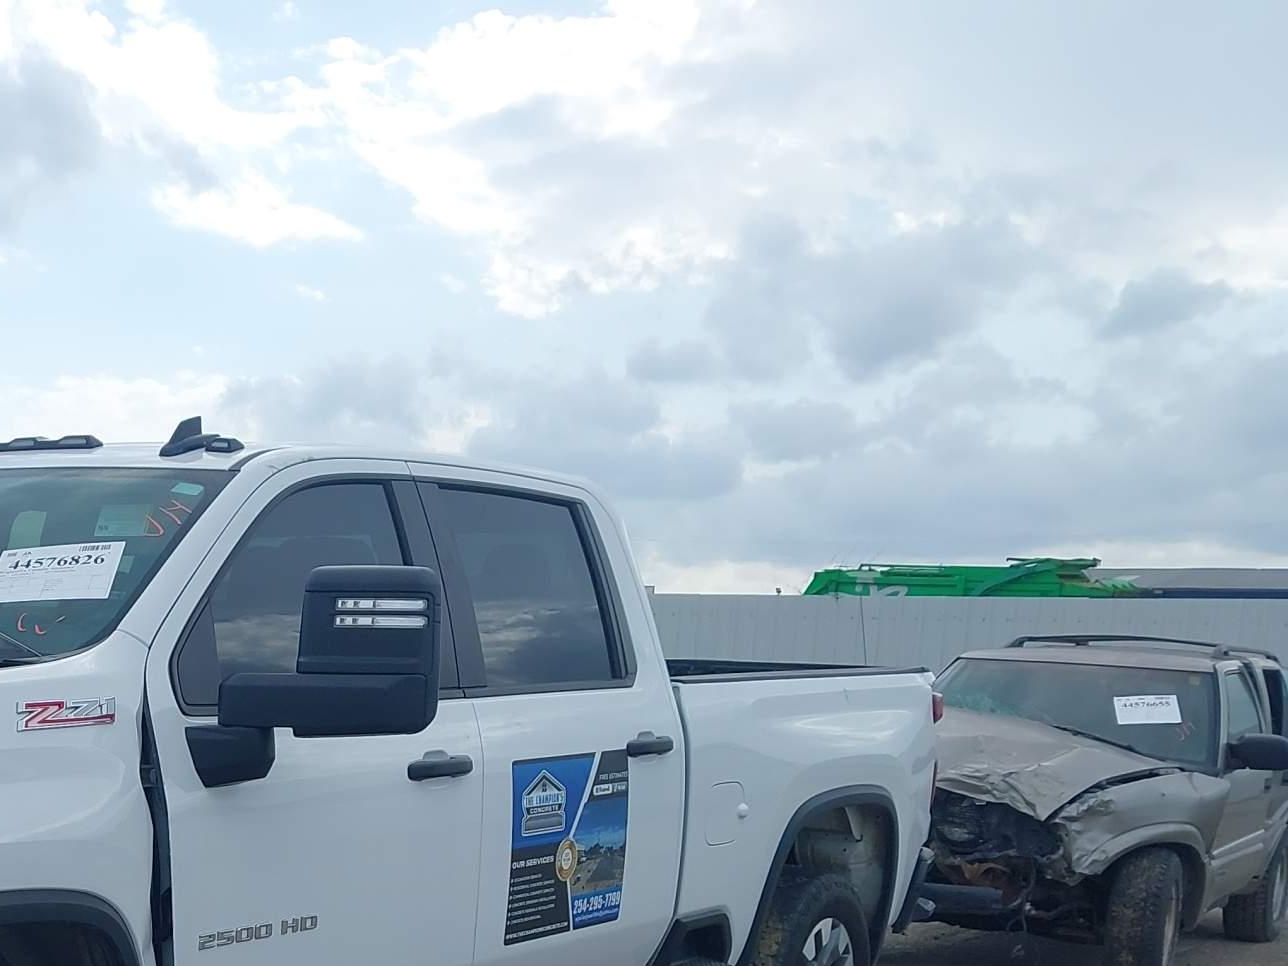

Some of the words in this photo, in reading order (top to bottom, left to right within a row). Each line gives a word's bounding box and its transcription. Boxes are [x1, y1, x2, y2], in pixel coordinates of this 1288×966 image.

[8, 554, 106, 570] 44576826
[529, 804, 559, 814] CONCRETE
[512, 860, 525, 869] OUR
[525, 855, 554, 867] SERVICES
[573, 890, 621, 914] 254-295-7799
[198, 923, 273, 951] 2500
[280, 915, 318, 936] HD
